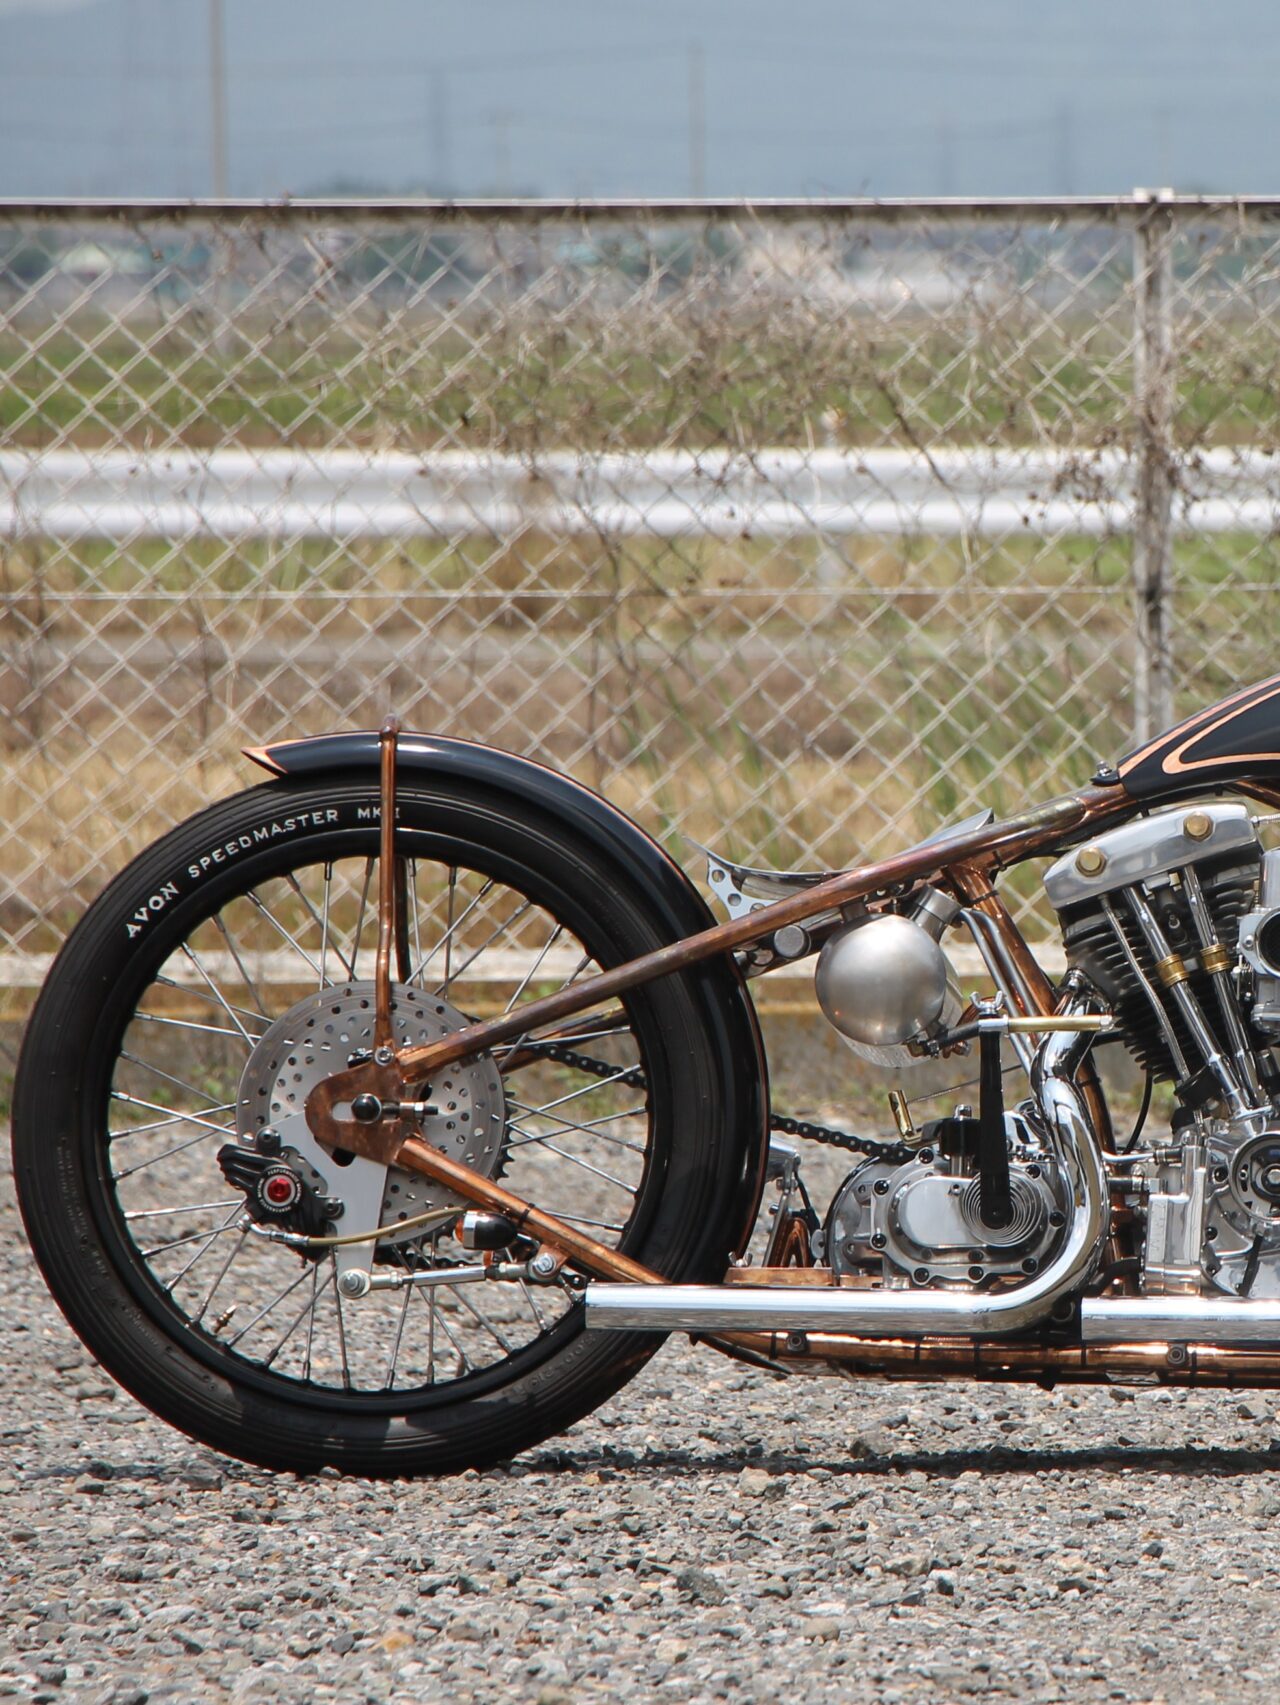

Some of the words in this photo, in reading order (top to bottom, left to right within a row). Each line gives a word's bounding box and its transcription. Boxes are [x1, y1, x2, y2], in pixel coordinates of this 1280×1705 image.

[125, 881, 180, 938] AVON
[188, 809, 340, 879] SPEEDMASTER
[357, 806, 400, 819] MKI
